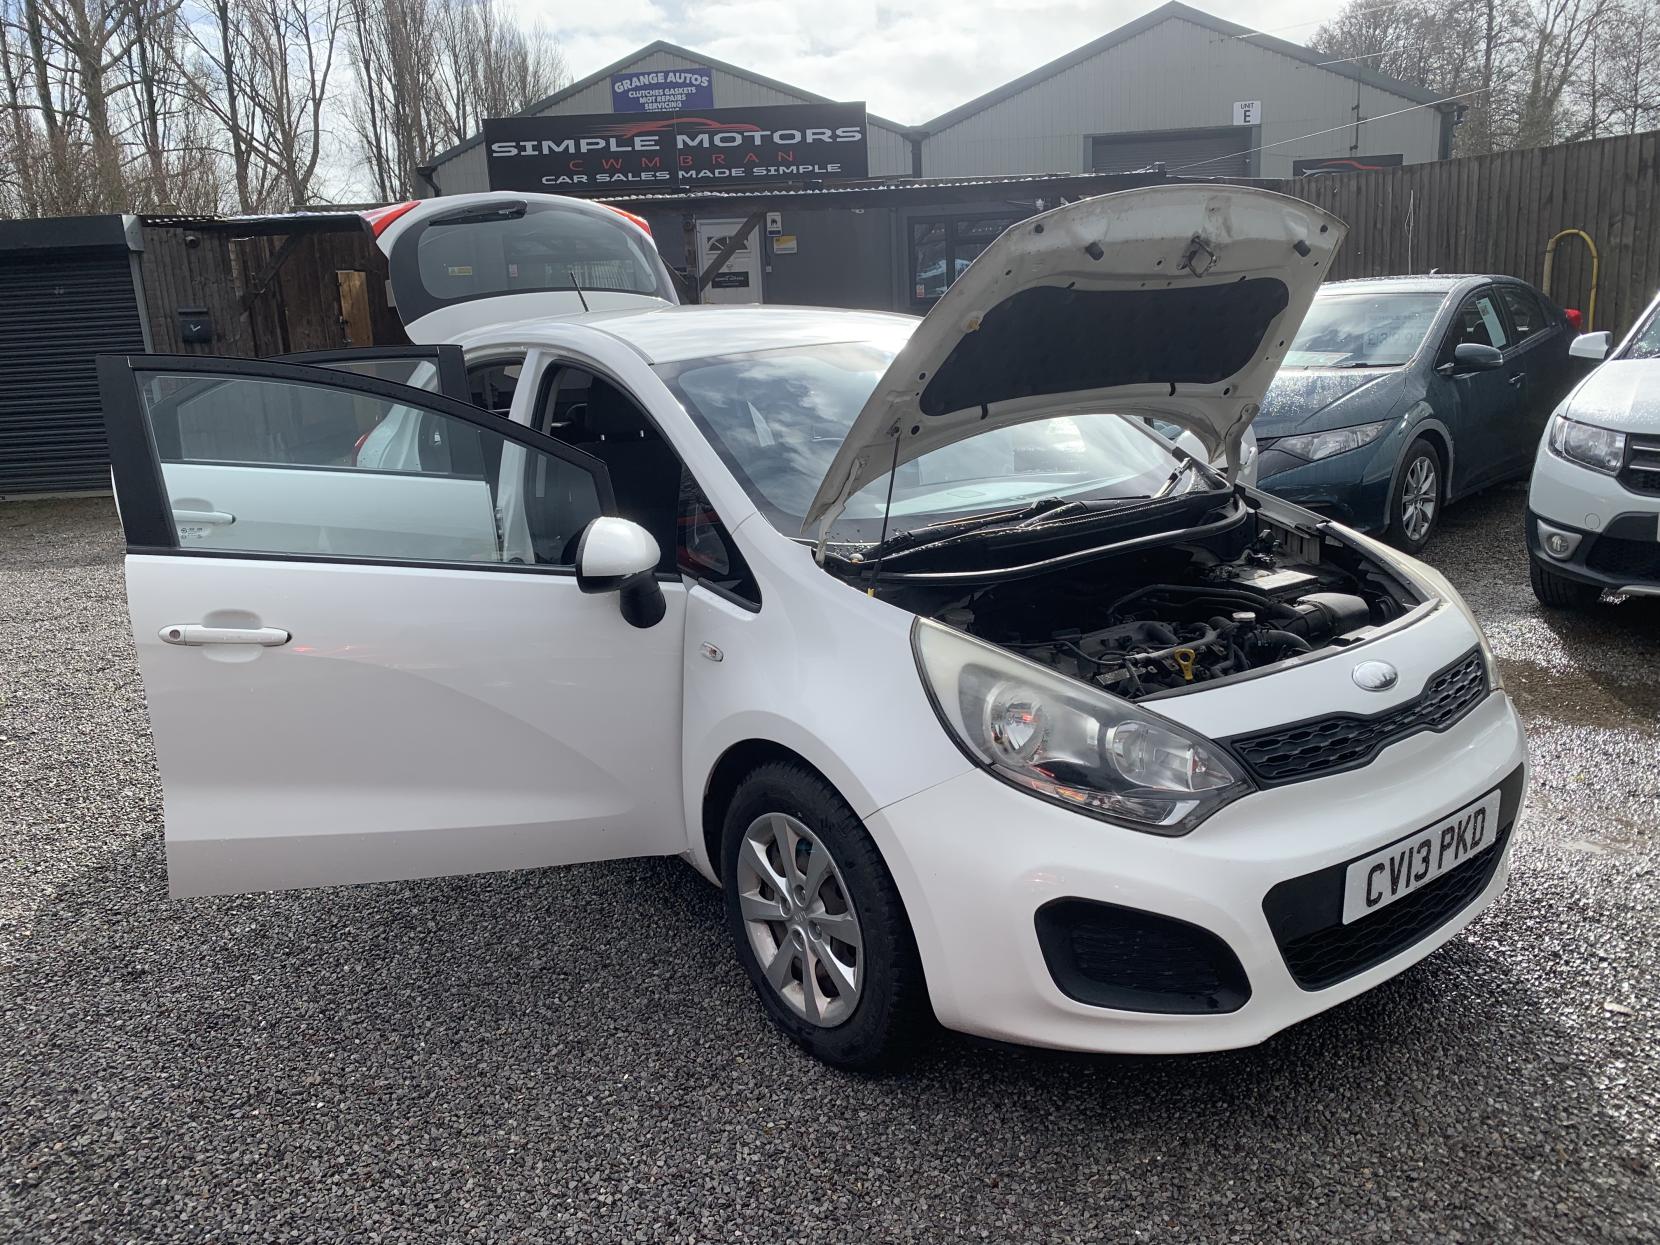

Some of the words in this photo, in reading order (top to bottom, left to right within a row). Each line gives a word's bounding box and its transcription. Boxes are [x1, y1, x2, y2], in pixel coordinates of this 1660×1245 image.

[614, 73, 665, 93] GRANGE
[666, 72, 709, 87] AUTOS
[628, 89, 663, 98] CLUTCHES
[665, 87, 696, 95] GASKETS
[644, 101, 682, 110] SERVICING
[1243, 109, 1251, 123] E
[491, 135, 661, 157] SIMPLE
[676, 126, 862, 149] MOTORS
[569, 151, 794, 171] CWMBRAN
[541, 174, 589, 185] CAR
[595, 171, 670, 183] SALES
[678, 167, 746, 179] MADE
[752, 163, 842, 176] SIMPLE
[1365, 838, 1432, 908] CV13
[1437, 806, 1487, 871] PKD
